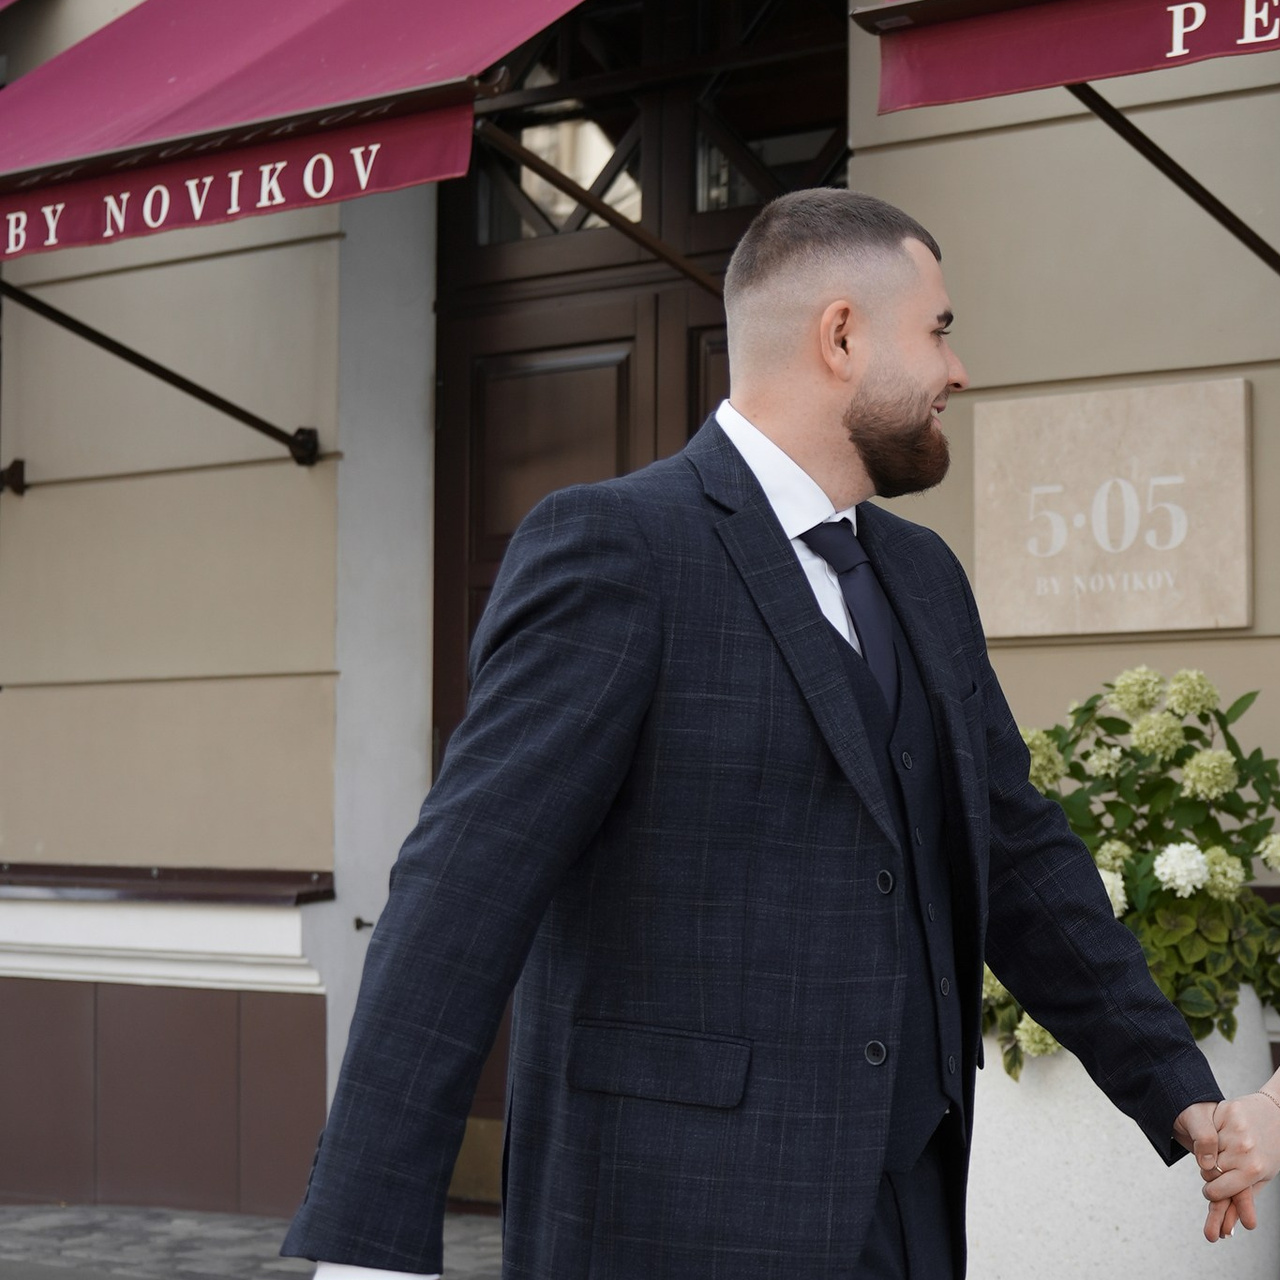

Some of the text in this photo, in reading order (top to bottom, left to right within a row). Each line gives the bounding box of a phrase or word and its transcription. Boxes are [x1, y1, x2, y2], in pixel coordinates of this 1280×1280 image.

[5, 143, 382, 255] BY NOVIKOV
[1035, 569, 1177, 597] BY NOVIKOV
